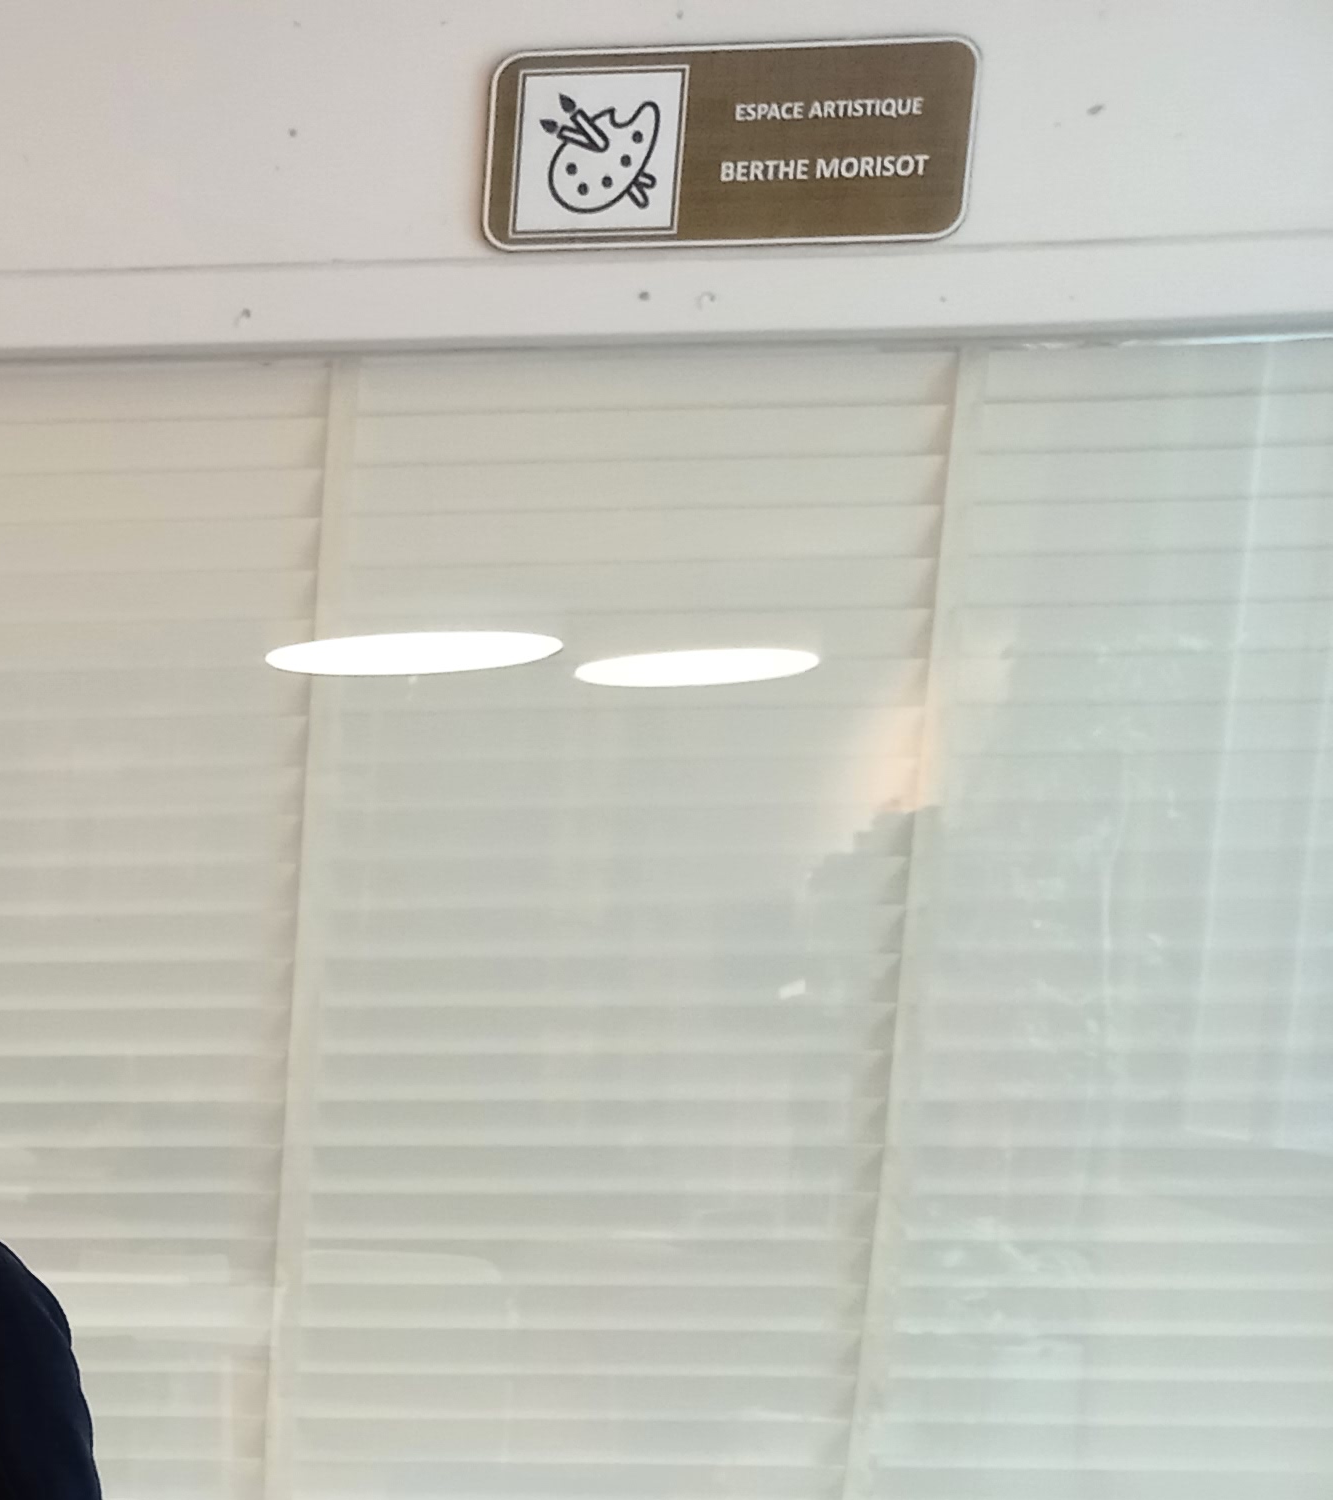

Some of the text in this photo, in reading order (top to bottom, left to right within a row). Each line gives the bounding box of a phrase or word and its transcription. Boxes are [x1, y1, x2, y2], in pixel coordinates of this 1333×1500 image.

[734, 96, 924, 121] ESPACE ARTISTIQUE
[720, 154, 930, 182] BERTHE MORISOT
